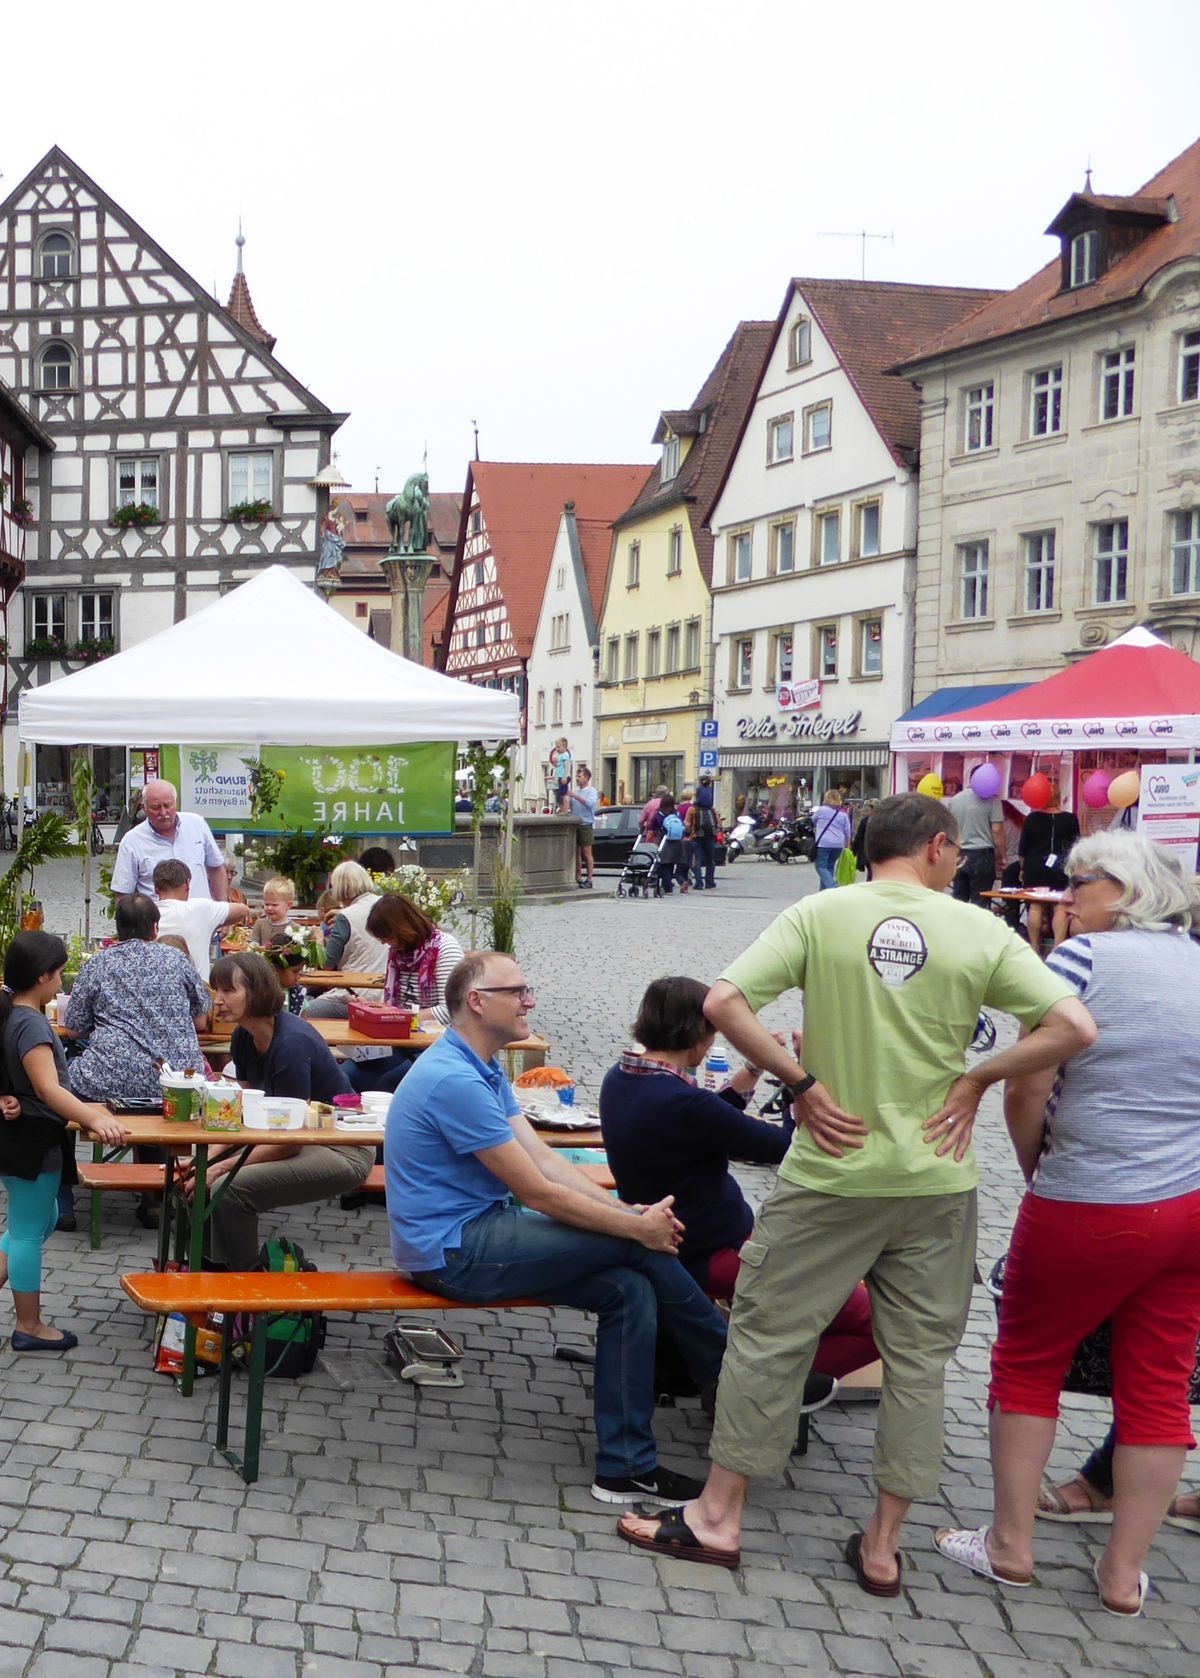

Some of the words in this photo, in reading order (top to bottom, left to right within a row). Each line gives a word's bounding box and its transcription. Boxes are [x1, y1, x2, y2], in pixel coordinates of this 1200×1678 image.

[704, 722, 715, 736] P
[1026, 728, 1041, 736] AWO
[1155, 726, 1173, 734] AWO
[703, 752, 714, 766] P
[1154, 784, 1170, 793] AWO
